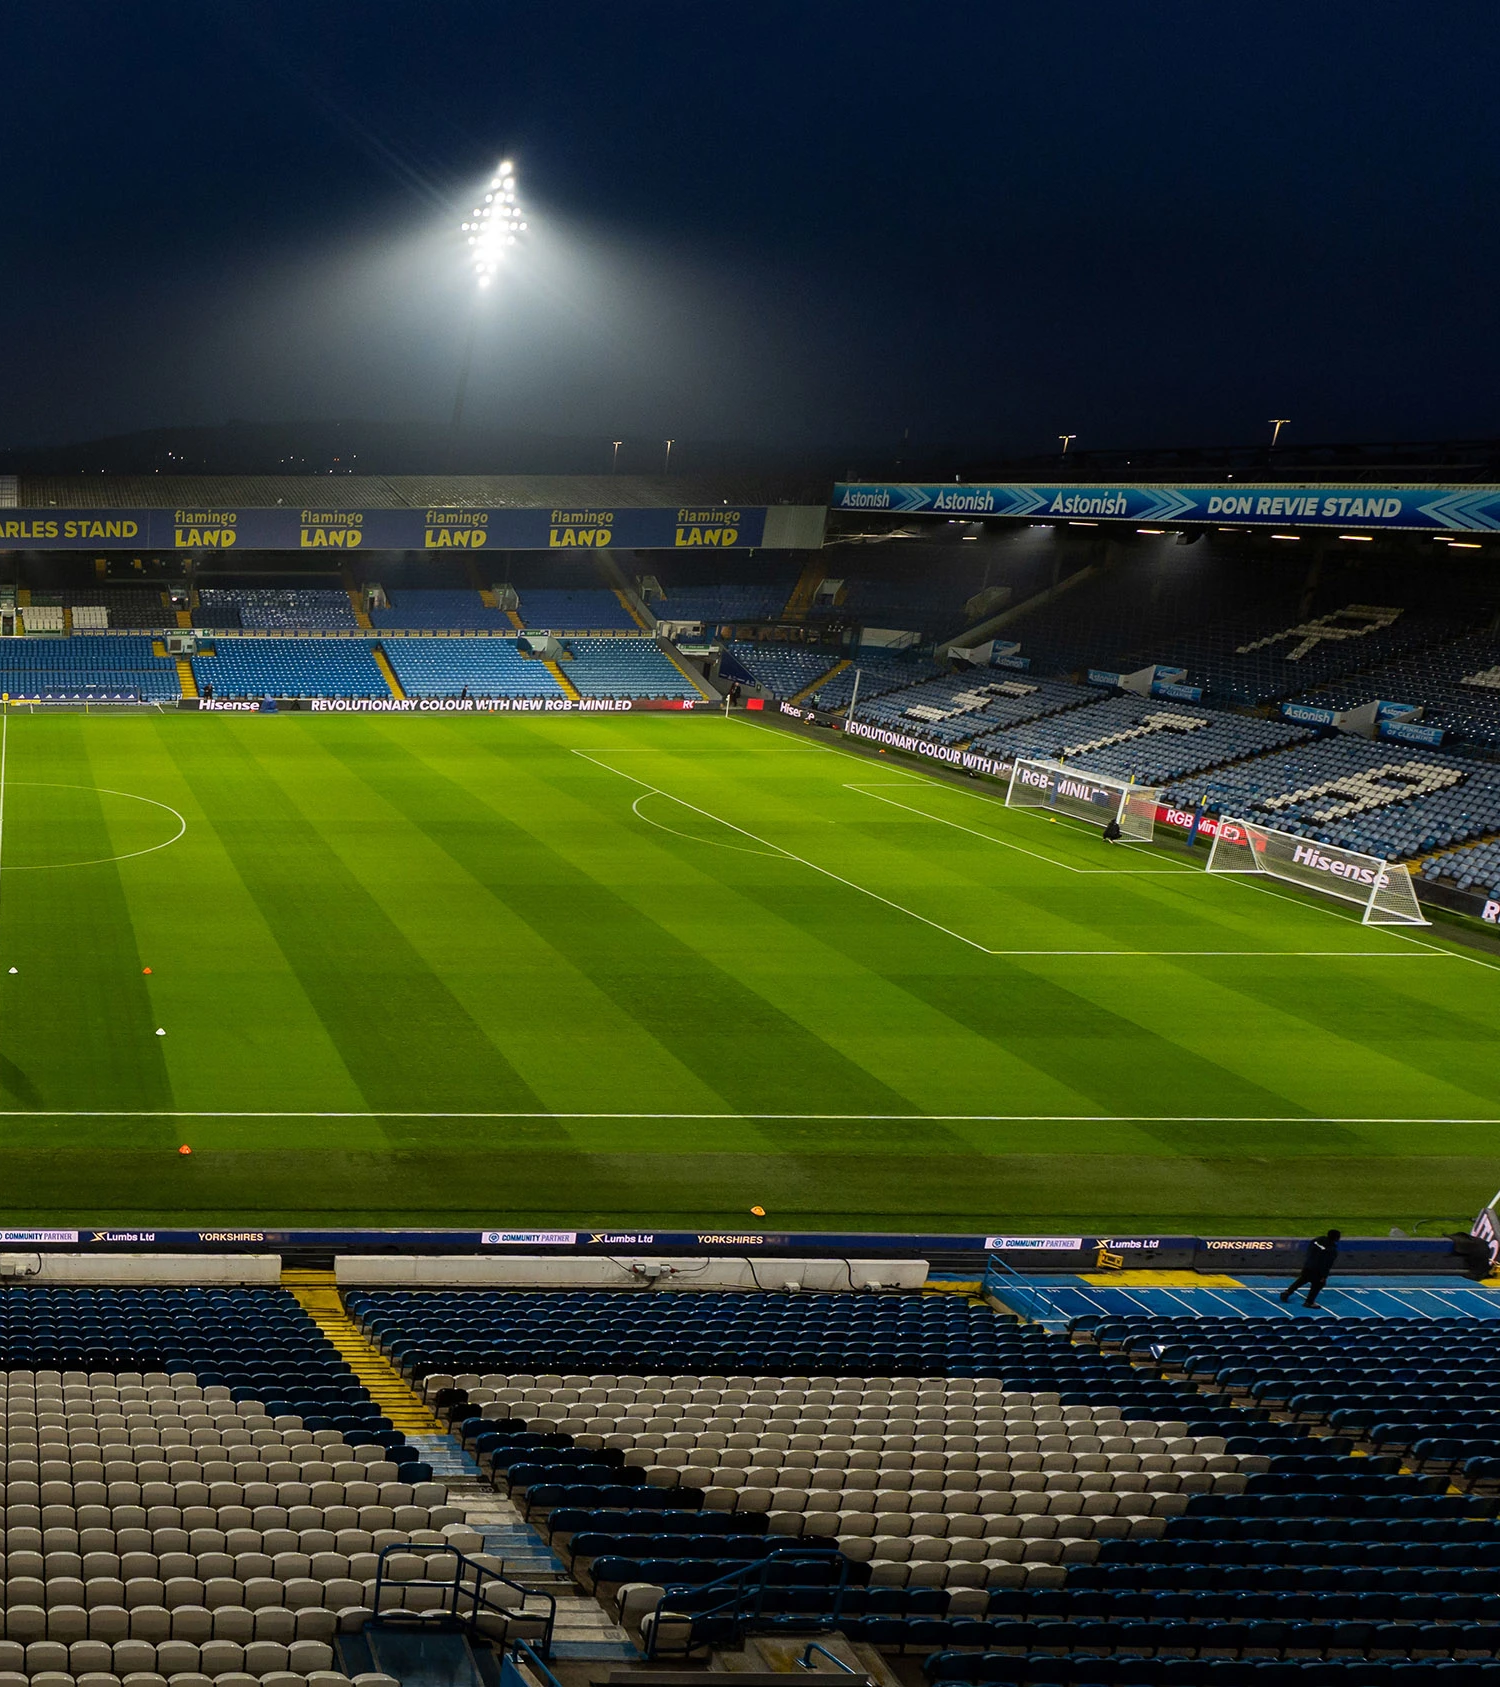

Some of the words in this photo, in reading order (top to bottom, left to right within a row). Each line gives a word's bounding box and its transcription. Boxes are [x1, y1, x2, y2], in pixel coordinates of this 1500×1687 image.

[840, 489, 890, 508] Astonish
[933, 490, 994, 511] Astonish
[1050, 491, 1127, 515] Astonish
[1207, 496, 1254, 515] DON
[1256, 497, 1321, 517] REVIE
[1324, 498, 1402, 518] STAND
[174, 510, 237, 527] flamingo
[301, 510, 363, 527] flamingo
[425, 510, 488, 527] flamingo
[550, 509, 614, 526] flamingo
[677, 508, 740, 526] flamingo
[64, 520, 138, 538] STAND
[675, 528, 738, 547] LAND
[175, 529, 236, 548] LAND
[300, 529, 362, 548] LAND
[425, 529, 487, 548] LAND
[549, 529, 611, 547] LAND
[1088, 671, 1119, 685] Astonish
[199, 700, 260, 711] Hisense
[311, 700, 418, 711] REVOLUTIONARY
[419, 700, 473, 711] COLOUR
[475, 700, 510, 711] WITH
[512, 700, 544, 711] NEW
[545, 700, 632, 711] RGB-MINILED
[1284, 706, 1331, 724] Astonish
[919, 741, 961, 764] COLOUR
[962, 752, 992, 775] WITH
[1022, 769, 1109, 803] RGB-MINIL
[1166, 809, 1194, 830] RGB
[1292, 845, 1391, 889] Hisense
[5, 1232, 43, 1240] COMMUNITY
[44, 1232, 73, 1240] PARTNER
[107, 1232, 138, 1241] Lumbs
[140, 1232, 155, 1241] Ltd
[198, 1233, 264, 1242] YORKSHIRES
[502, 1234, 540, 1243] COMMUNITY
[541, 1234, 570, 1243] PARTNER
[604, 1234, 635, 1243] Lumbs
[637, 1234, 653, 1243] Ltd
[697, 1235, 763, 1244] YORKSHIRES
[1005, 1239, 1045, 1248] COMMUNITY
[1046, 1239, 1075, 1248] PARTNER
[1110, 1239, 1141, 1249] Lumbs
[1143, 1239, 1159, 1249] Ltd
[1206, 1241, 1273, 1251] YORKSHIRES
